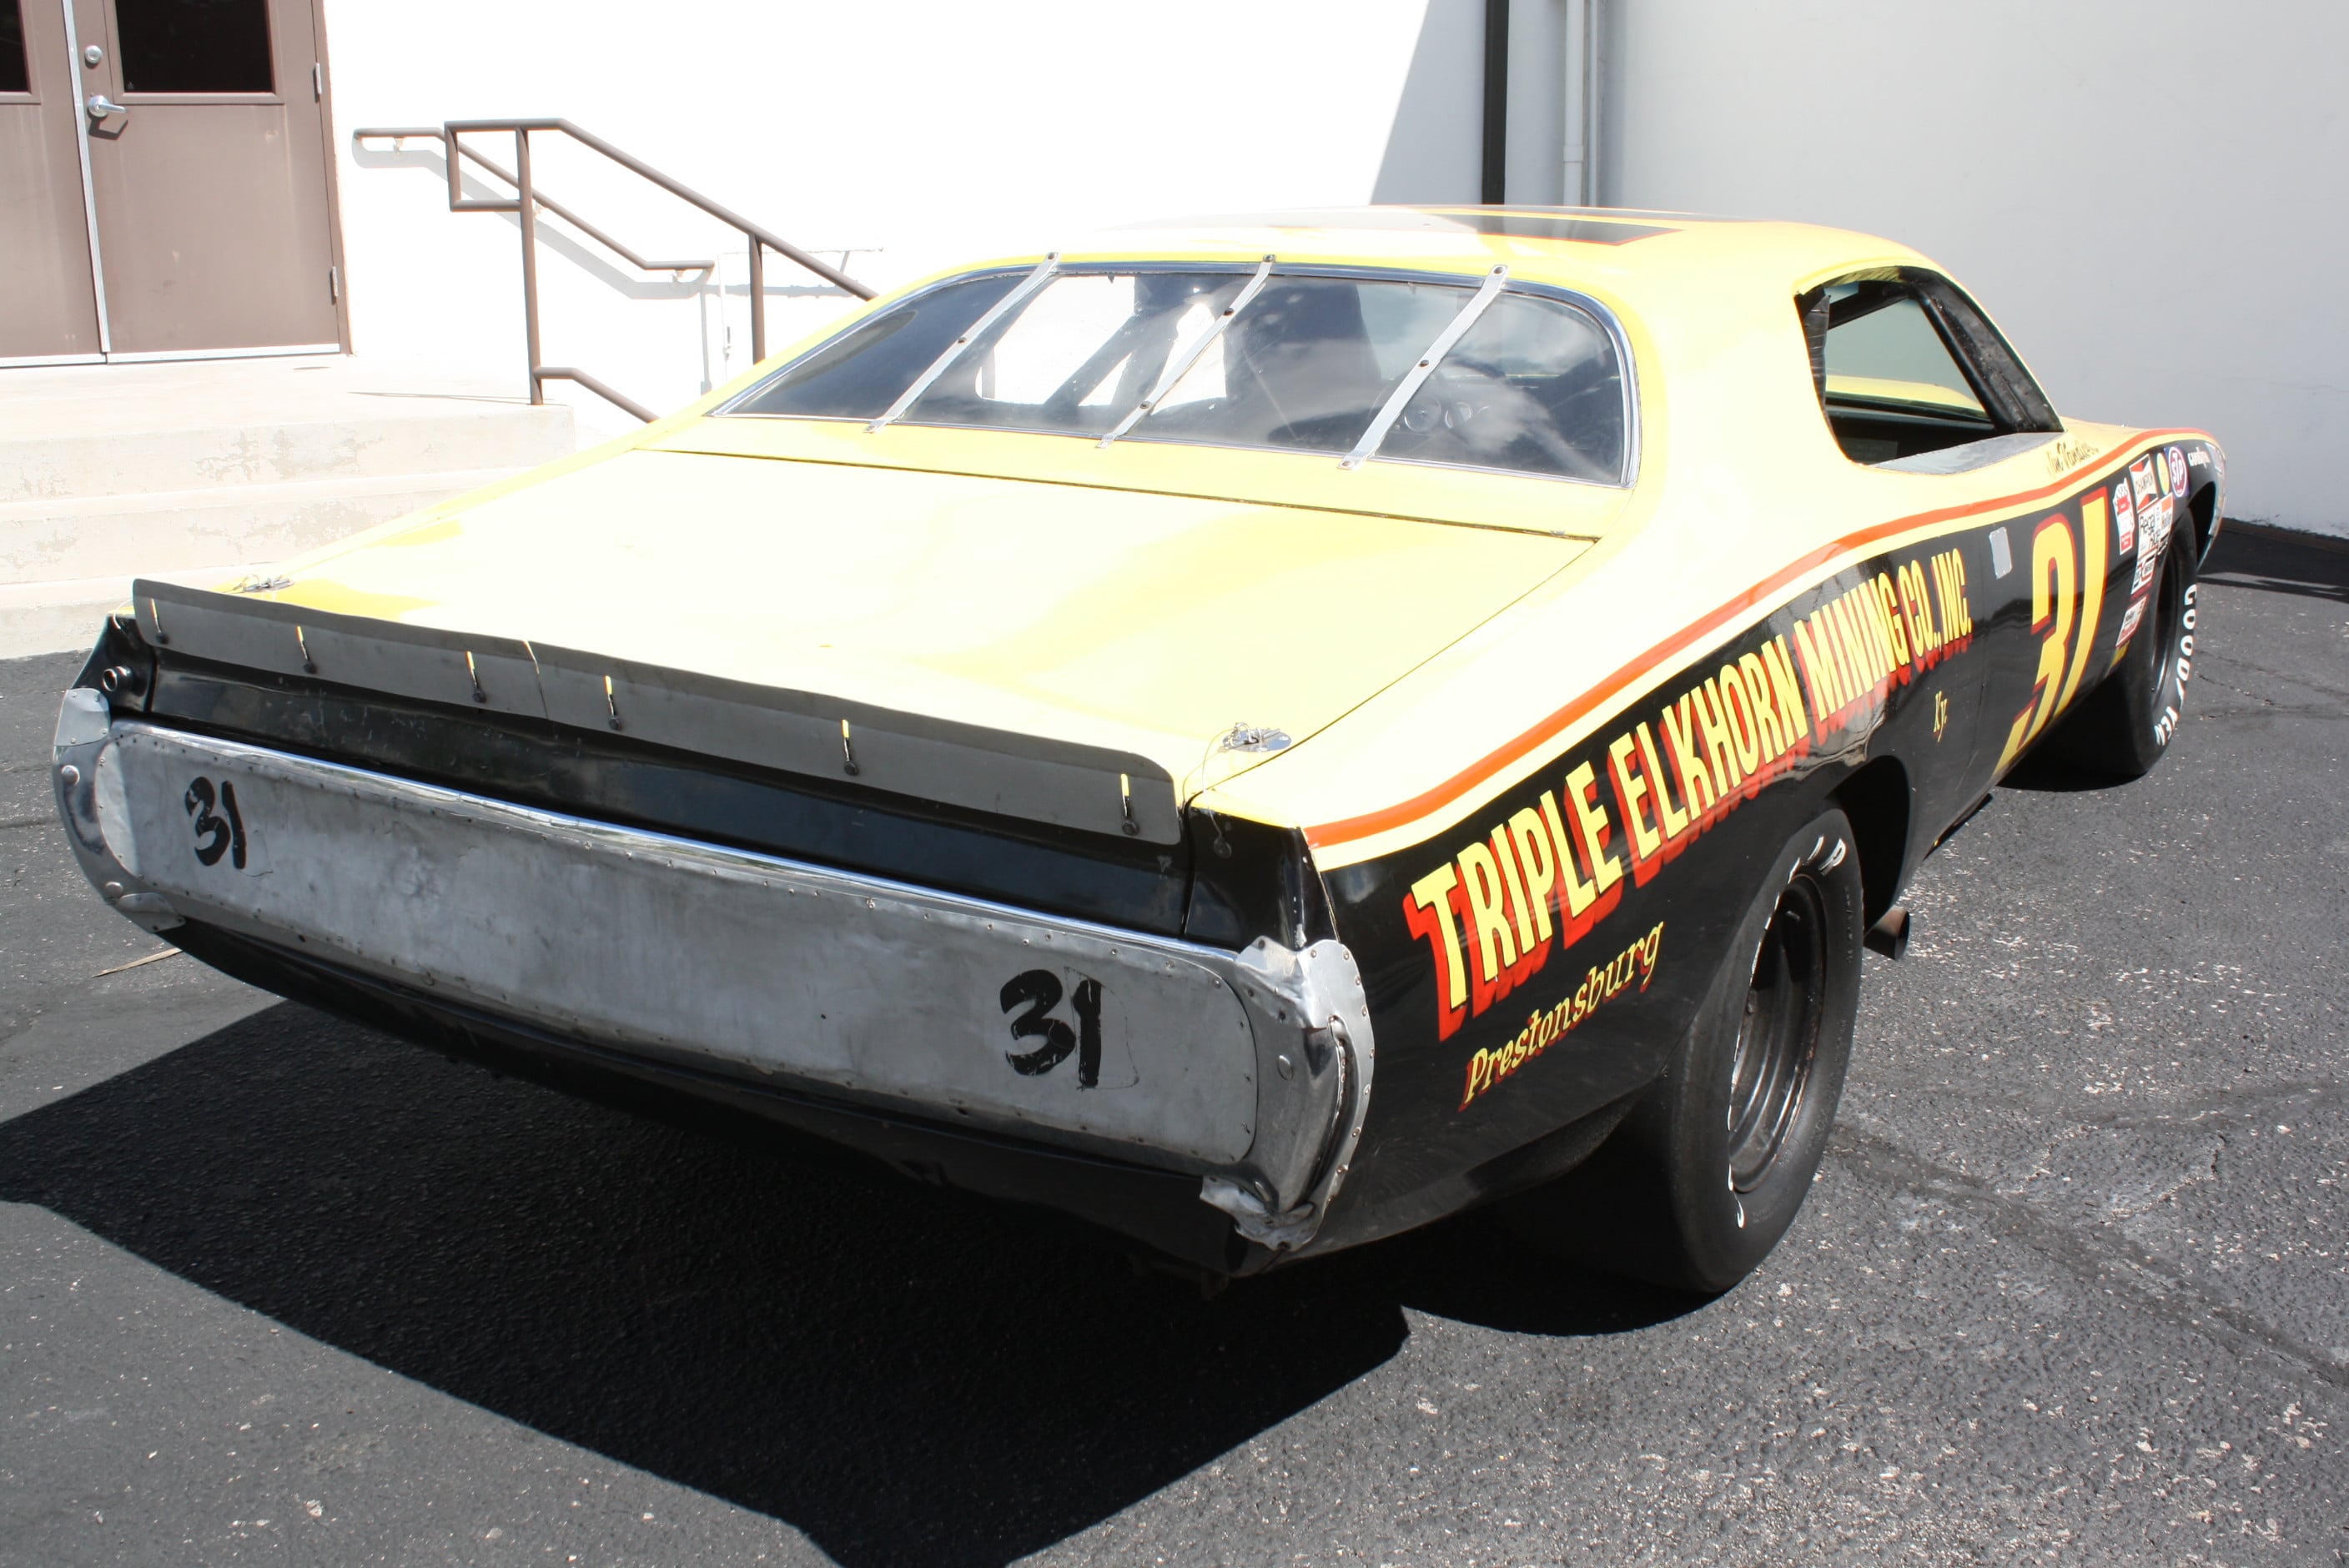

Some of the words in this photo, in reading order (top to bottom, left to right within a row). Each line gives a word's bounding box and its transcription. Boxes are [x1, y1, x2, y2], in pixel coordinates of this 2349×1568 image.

[2170, 451, 2185, 485] STP
[1992, 486, 2109, 777] 31
[1933, 690, 1949, 743] Ky.
[184, 776, 248, 869] 31
[1406, 760, 1624, 1024] TRIPLE
[1607, 633, 1809, 871] ELKHORN
[1793, 571, 1911, 731] MINING
[1930, 547, 1974, 646] INC.
[999, 968, 1102, 1090] 31
[1461, 921, 1665, 1108] Prestonsburg
